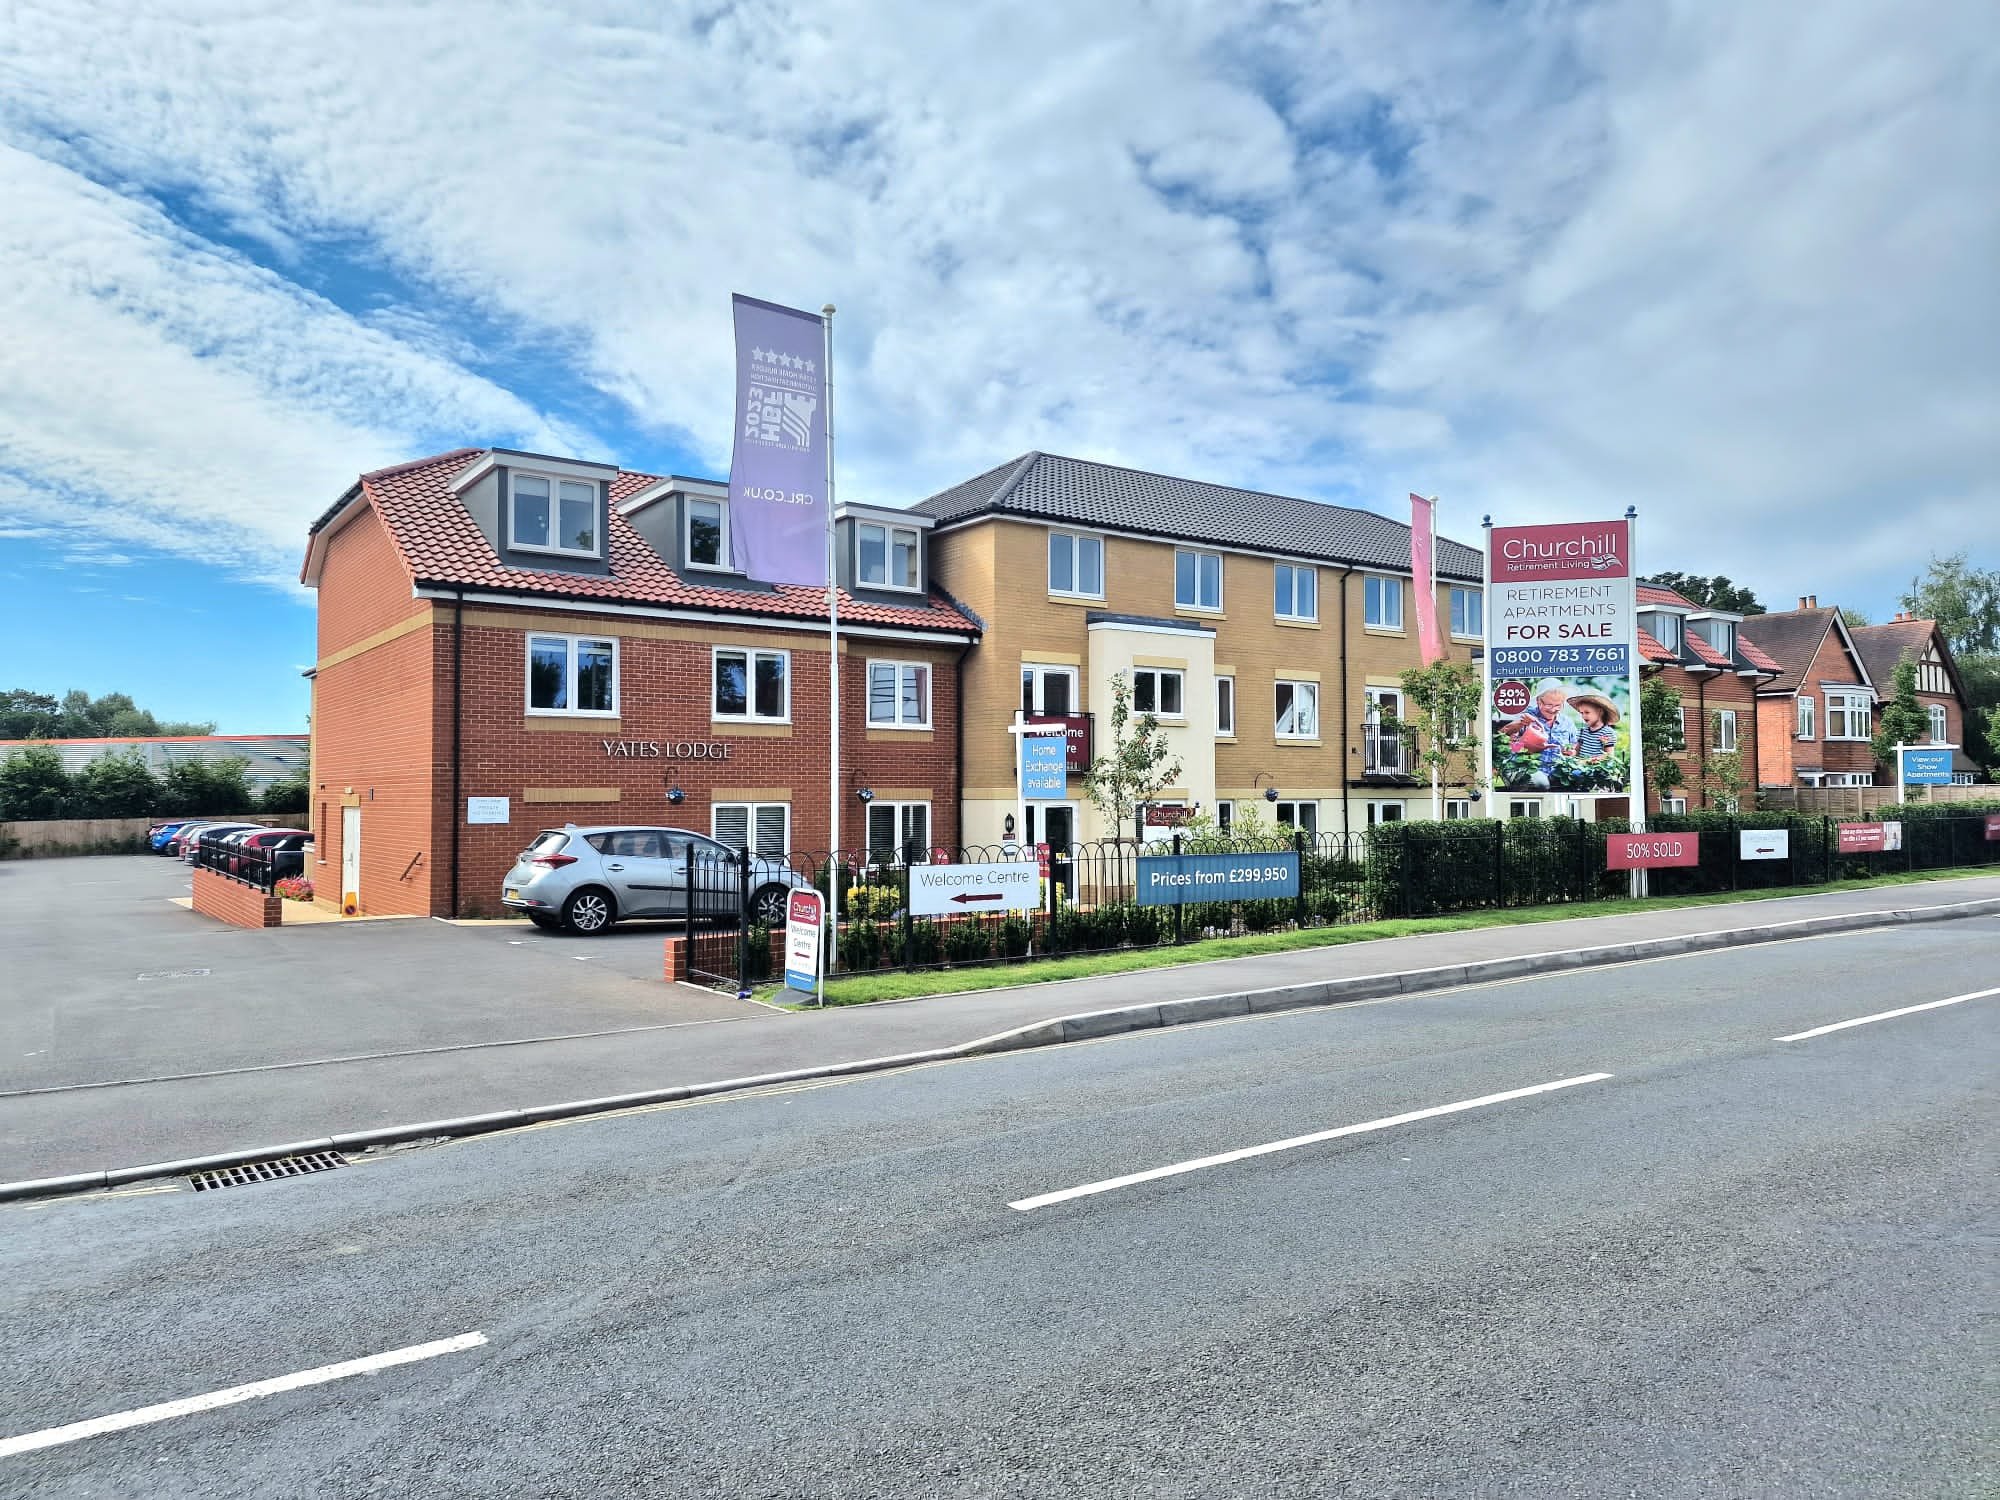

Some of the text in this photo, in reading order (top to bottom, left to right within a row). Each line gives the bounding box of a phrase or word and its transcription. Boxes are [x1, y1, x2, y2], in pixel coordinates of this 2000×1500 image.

[1503, 533, 1616, 559] Churchill
[1507, 560, 1590, 572] Retirement Living
[1507, 585, 1613, 601] RETIREMENT
[1503, 603, 1617, 619] APARTMENTS
[1507, 622, 1613, 640] FOR SALE
[1495, 647, 1625, 663] 0800 783 7661
[1496, 663, 1626, 676] churchillretirement.co.uk
[1499, 688, 1525, 698] 50%
[1497, 698, 1527, 707] SOLD
[602, 739, 732, 759] YATES LODGE
[1032, 744, 1057, 756] Home
[1025, 760, 1064, 774] Exchange
[1027, 775, 1062, 788] available
[1626, 841, 1682, 859] 50% SOLD
[920, 870, 1030, 888] Welcome Centre
[1151, 867, 1288, 886] Prices from £299,950
[790, 924, 816, 939] Welcome
[793, 938, 812, 950] Centre
